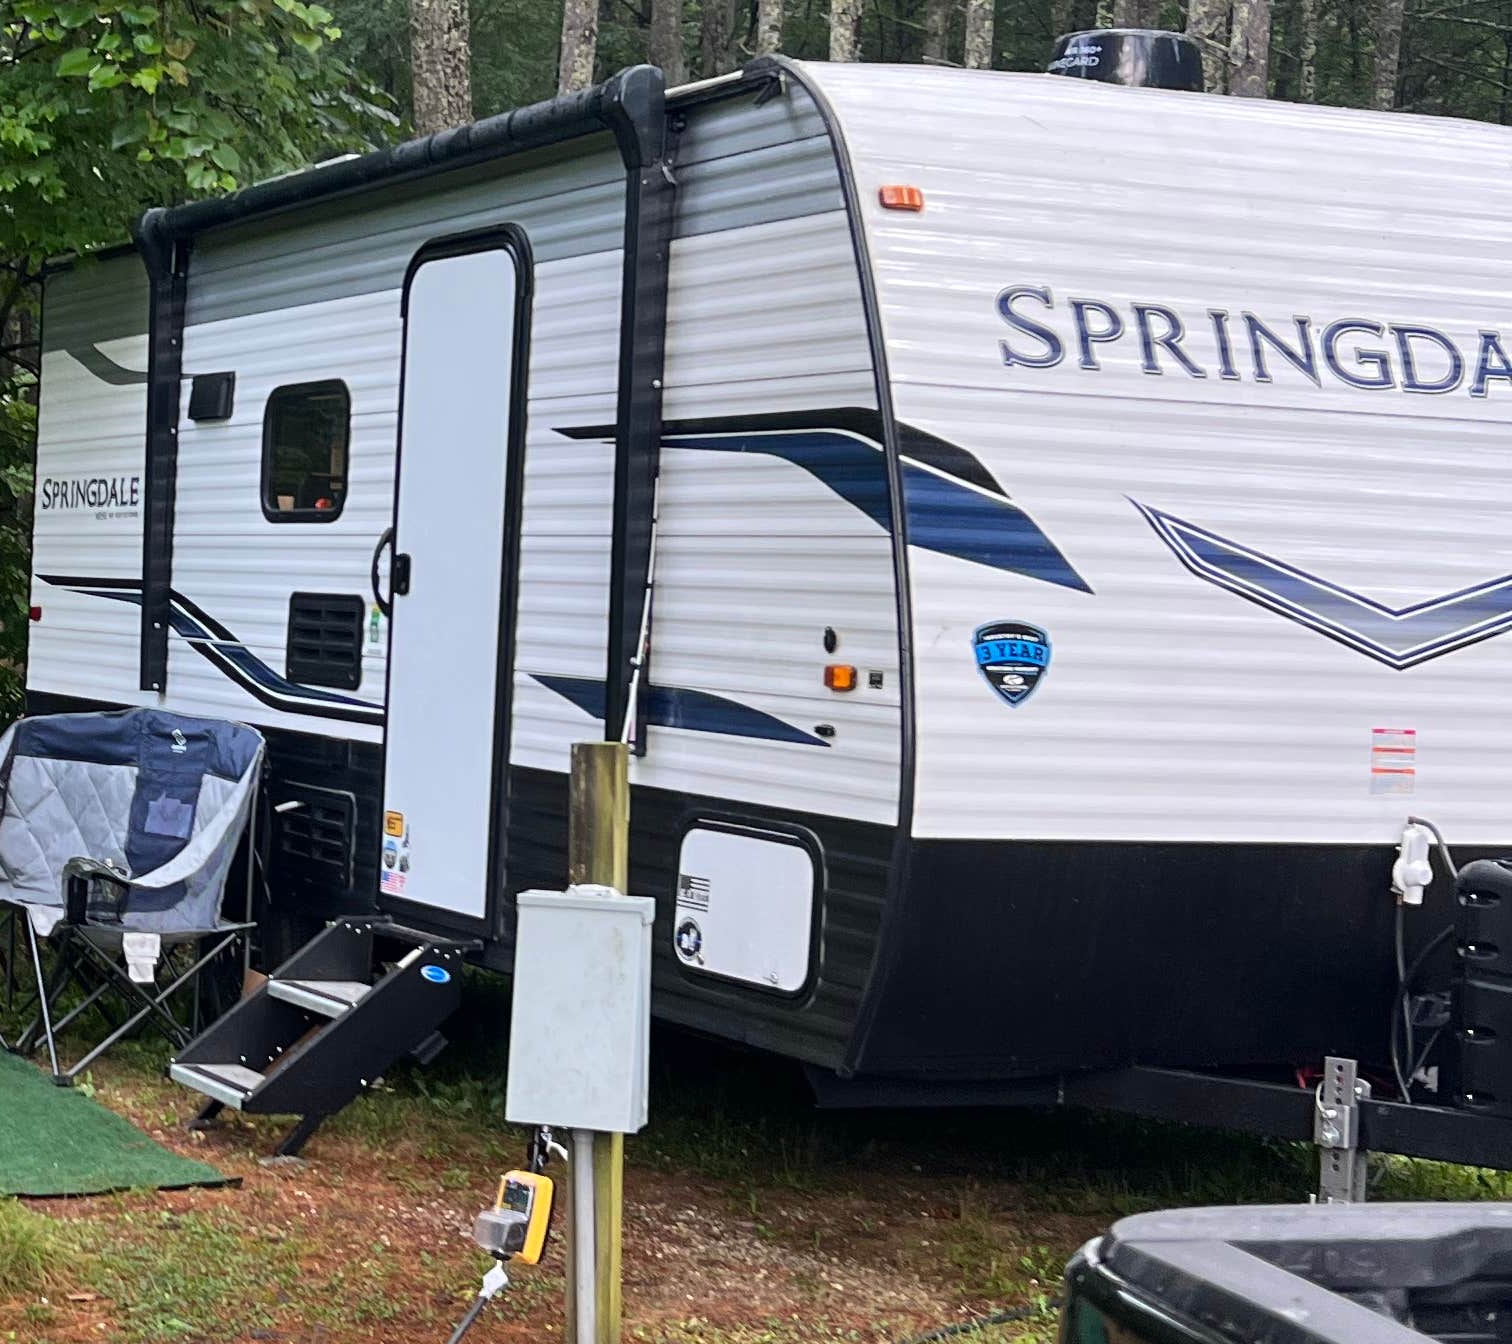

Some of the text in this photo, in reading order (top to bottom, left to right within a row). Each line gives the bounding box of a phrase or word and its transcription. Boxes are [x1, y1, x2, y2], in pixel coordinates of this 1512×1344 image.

[994, 283, 1512, 399] SPRINGDA
[42, 477, 139, 509] SPRINGDALE
[981, 642, 1044, 662] 3 YEAR
